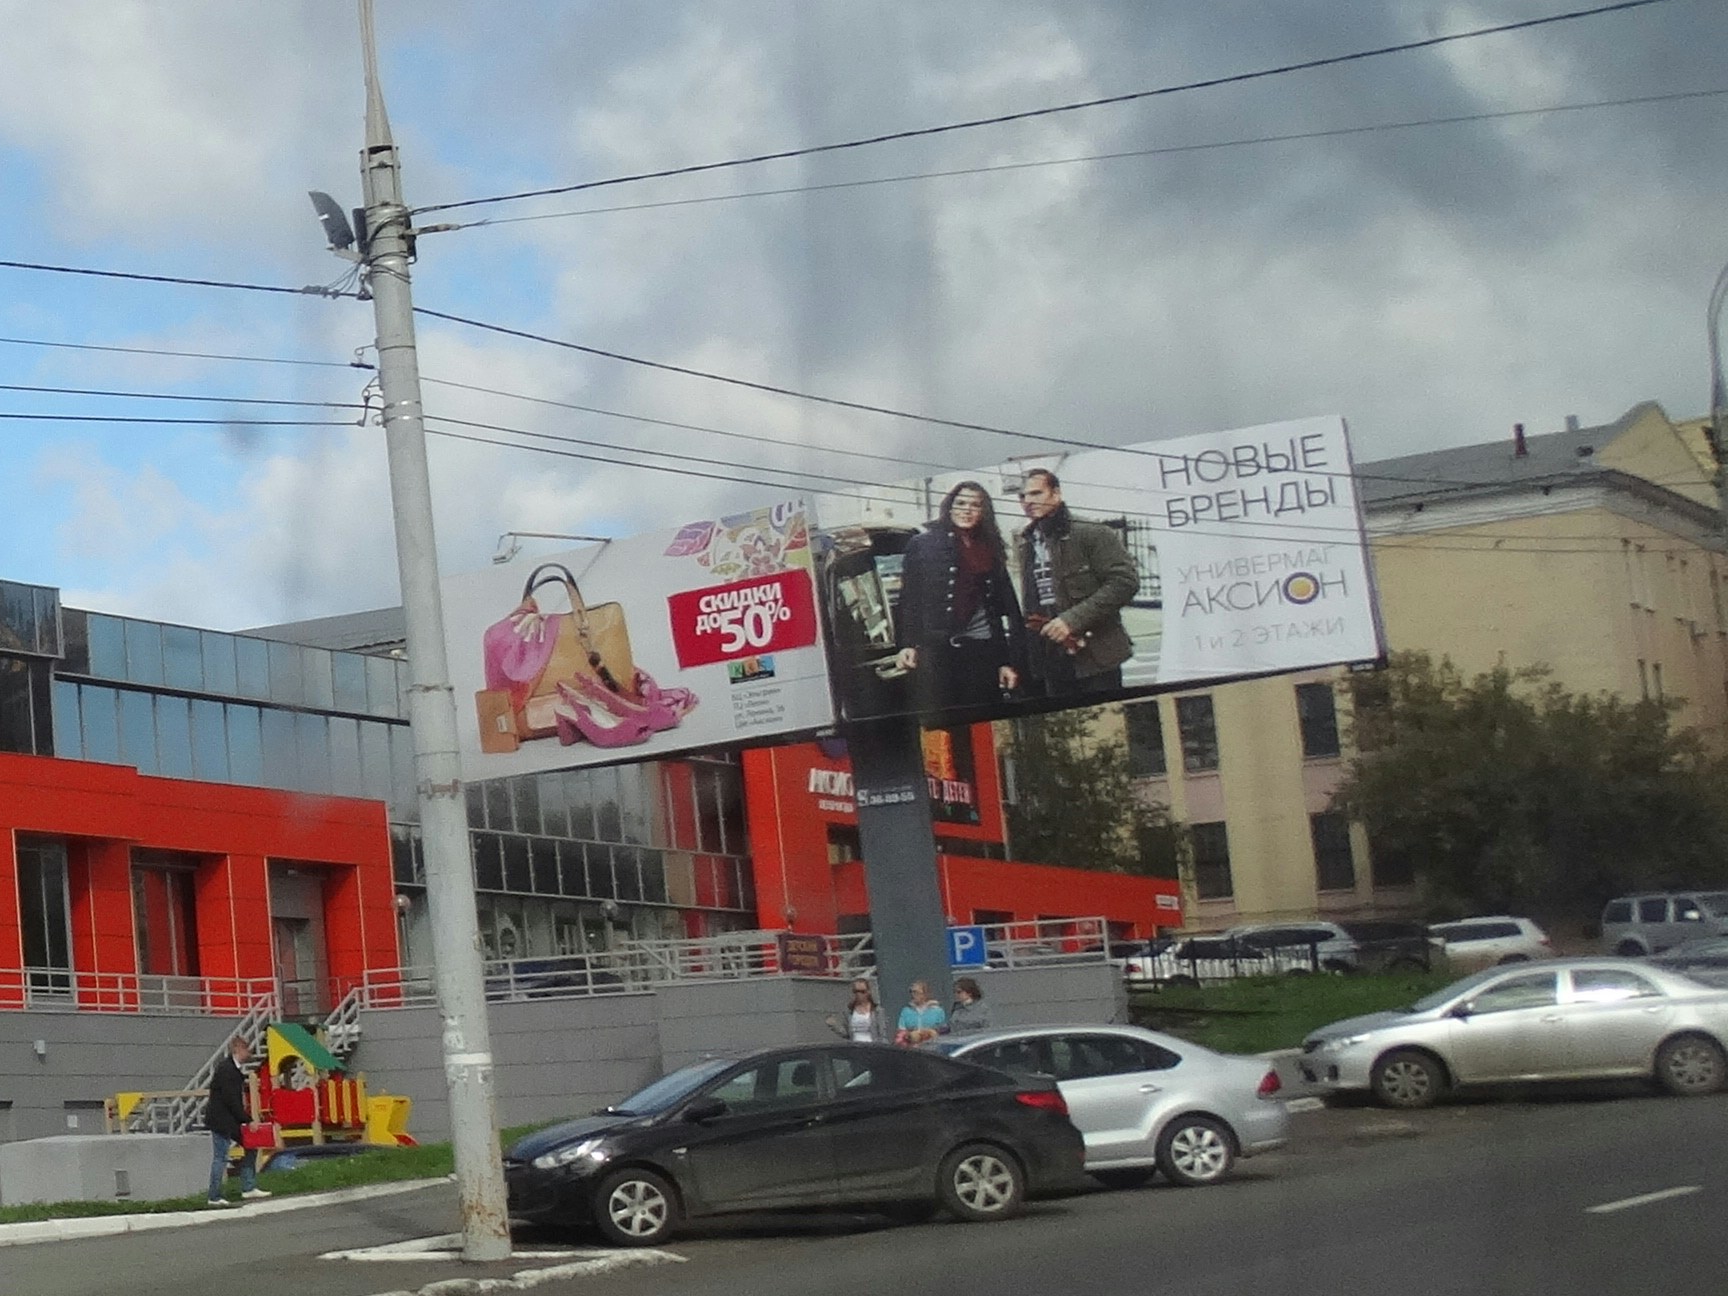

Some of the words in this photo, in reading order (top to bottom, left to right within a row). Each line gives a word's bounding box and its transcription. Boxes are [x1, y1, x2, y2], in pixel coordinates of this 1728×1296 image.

[1159, 434, 1327, 489] НОВЫЕ
[1166, 477, 1335, 528] БРЕНДЫ
[1177, 545, 1336, 584] УНИВЕРМАГ
[699, 582, 782, 613] СКИДКИ
[1182, 570, 1347, 617] АКСИОН
[720, 599, 791, 653] 50%
[1251, 617, 1345, 645] ЭТАЖИ
